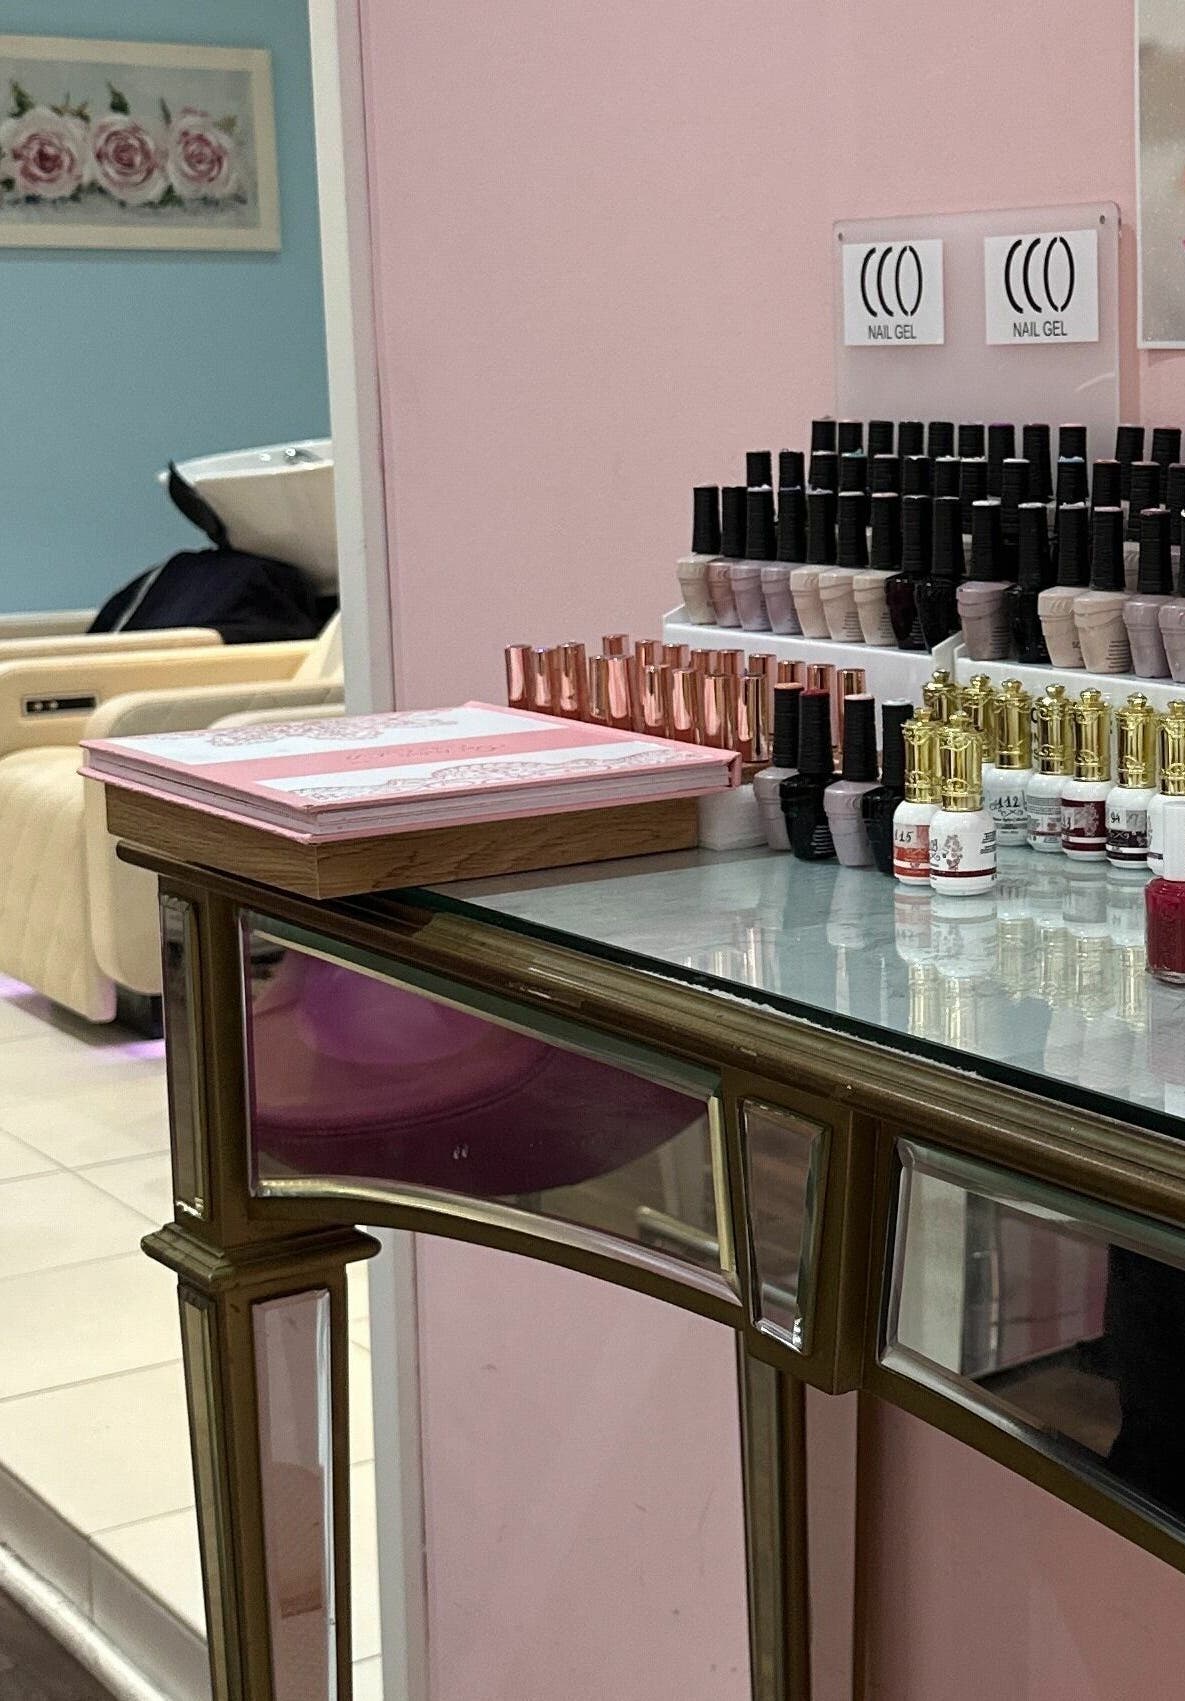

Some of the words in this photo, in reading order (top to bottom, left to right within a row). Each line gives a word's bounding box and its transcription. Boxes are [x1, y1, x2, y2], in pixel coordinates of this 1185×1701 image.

[868, 324, 891, 341] NAIL
[894, 323, 917, 339] GEL
[1013, 321, 1040, 337] NAIL
[1043, 320, 1068, 336] GEL
